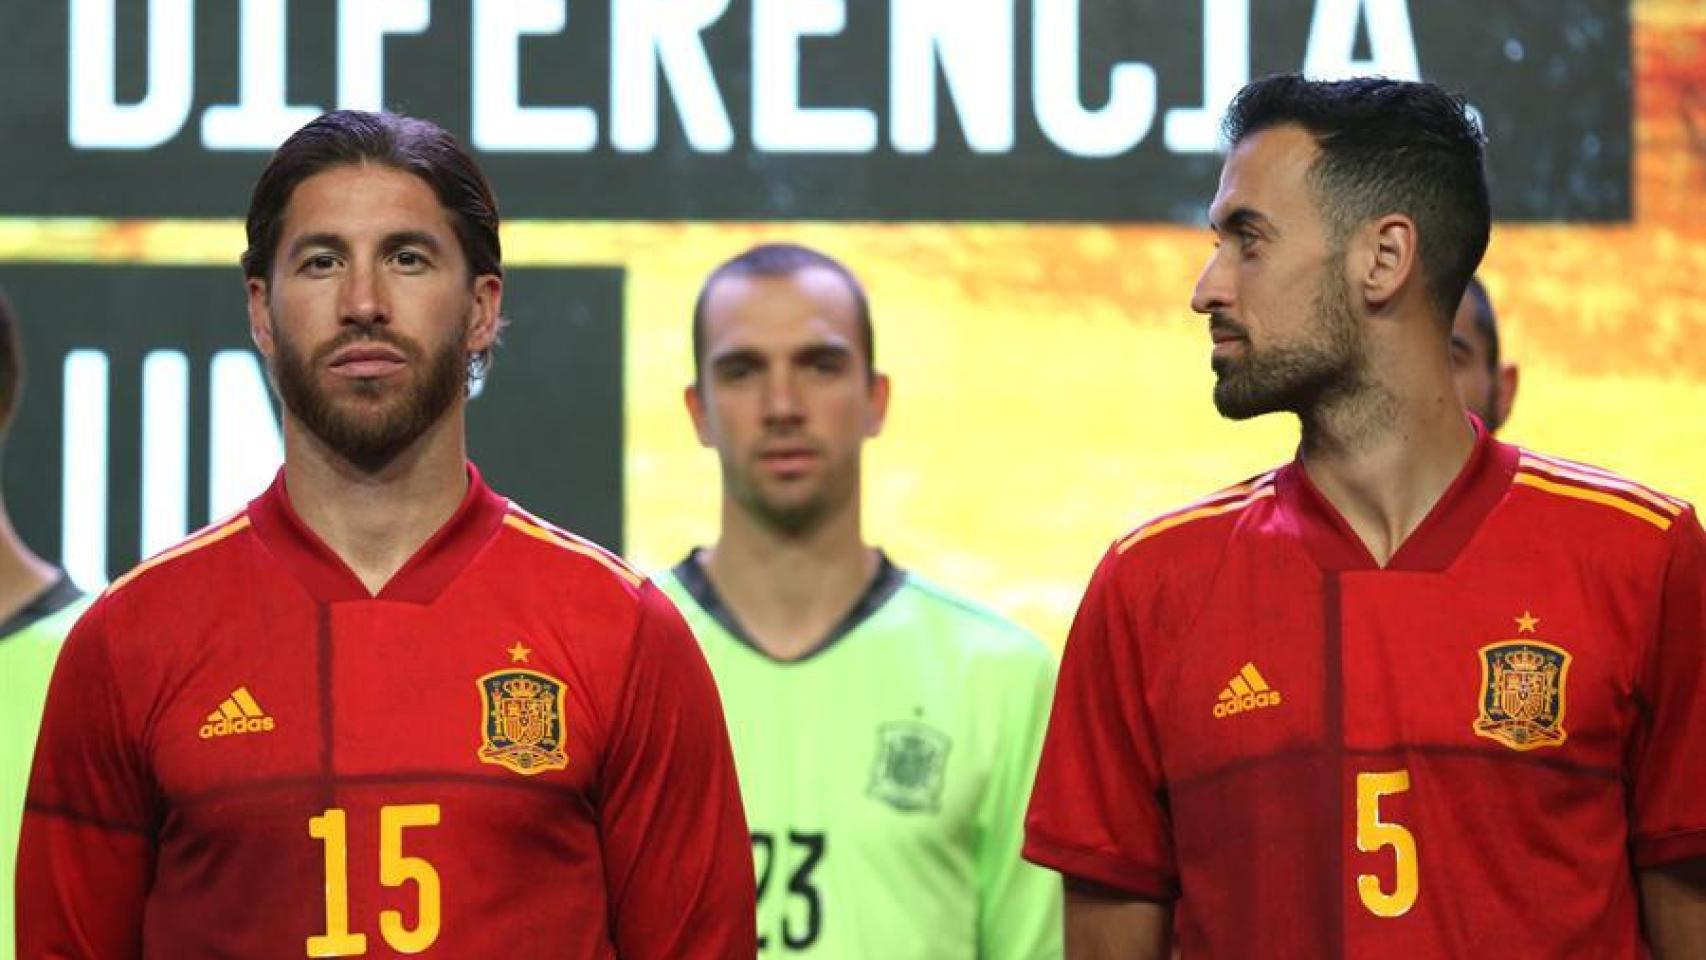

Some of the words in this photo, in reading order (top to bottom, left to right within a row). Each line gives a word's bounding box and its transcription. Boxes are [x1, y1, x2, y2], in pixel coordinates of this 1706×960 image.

[199, 716, 275, 739] adidas
[1213, 691, 1282, 718] adidas
[306, 803, 442, 958] 15
[1356, 769, 1419, 918] 5
